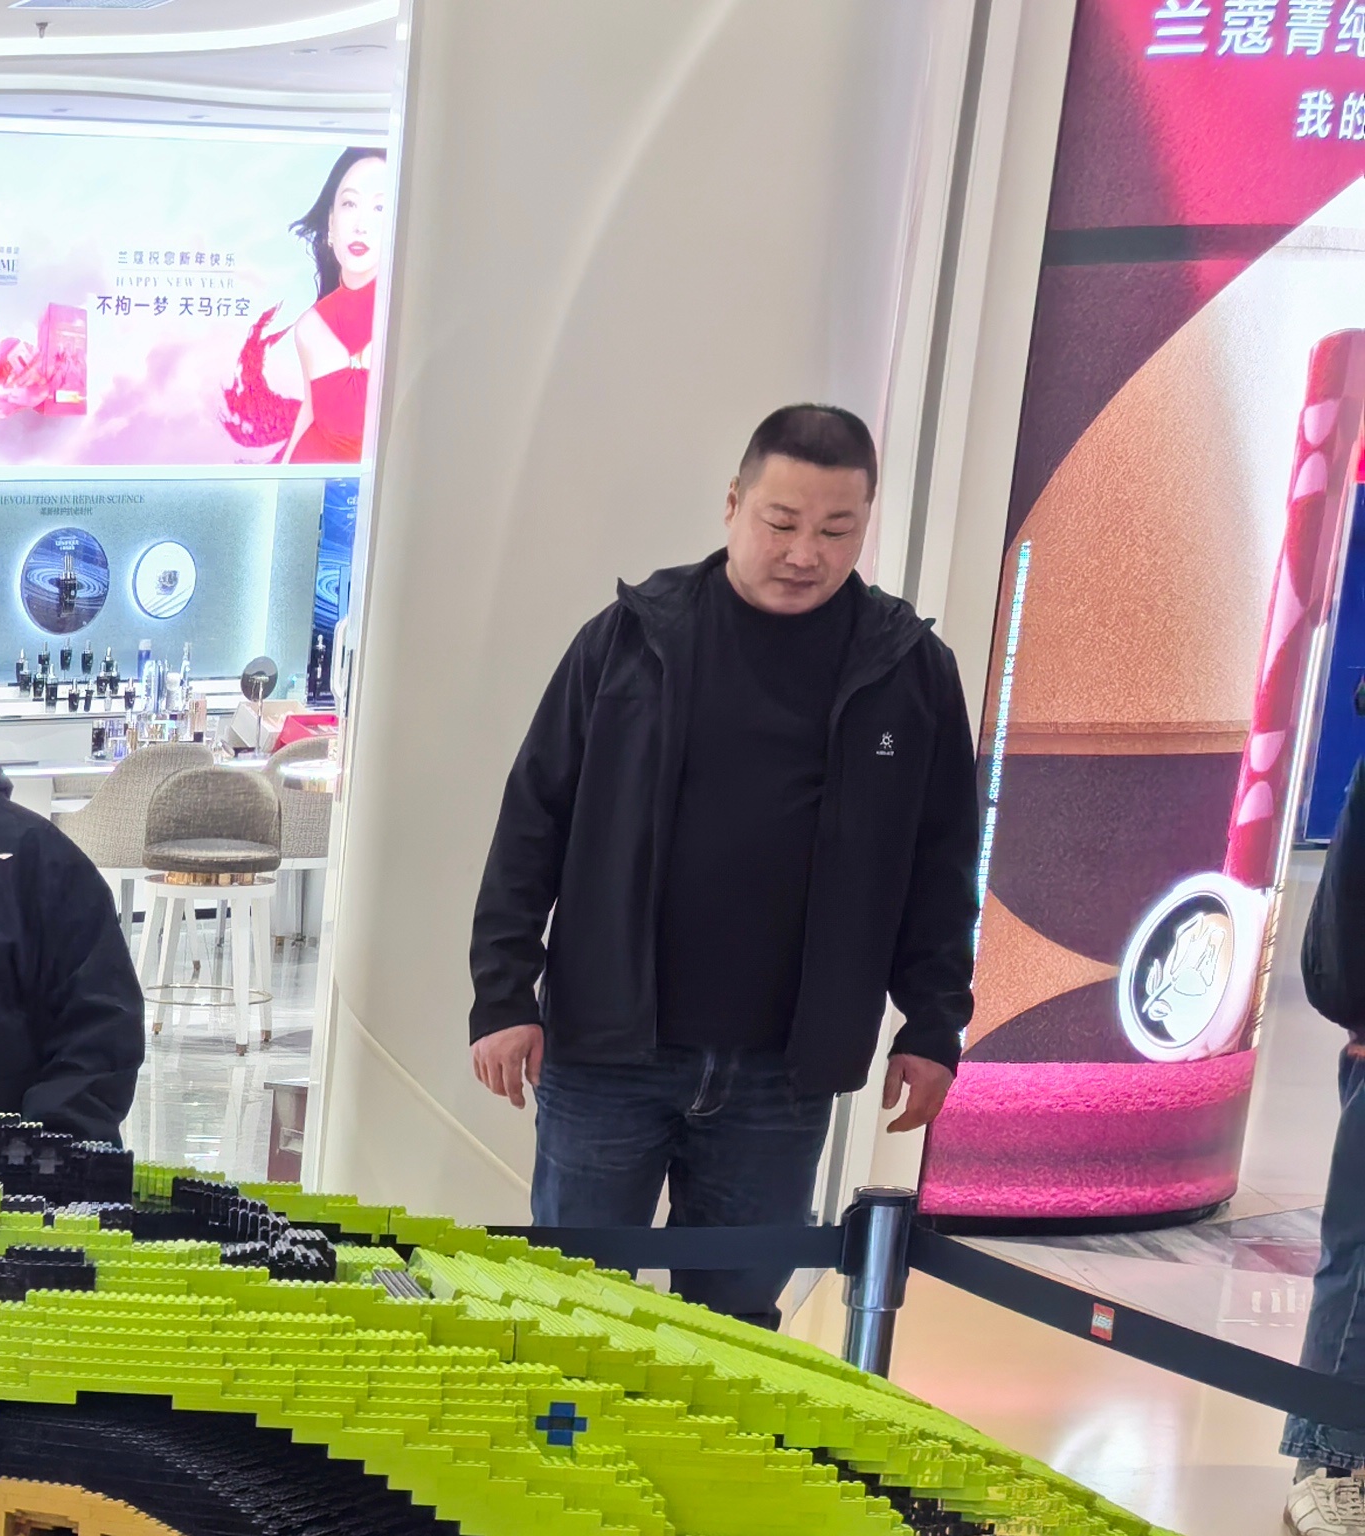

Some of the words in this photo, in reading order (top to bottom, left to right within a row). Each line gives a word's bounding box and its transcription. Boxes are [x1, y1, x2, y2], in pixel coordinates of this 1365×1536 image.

[116, 277, 159, 287] HAPPY
[167, 277, 194, 287] NEW
[97, 295, 169, 316] 不拘一梦
[179, 297, 250, 316] 天马行空
